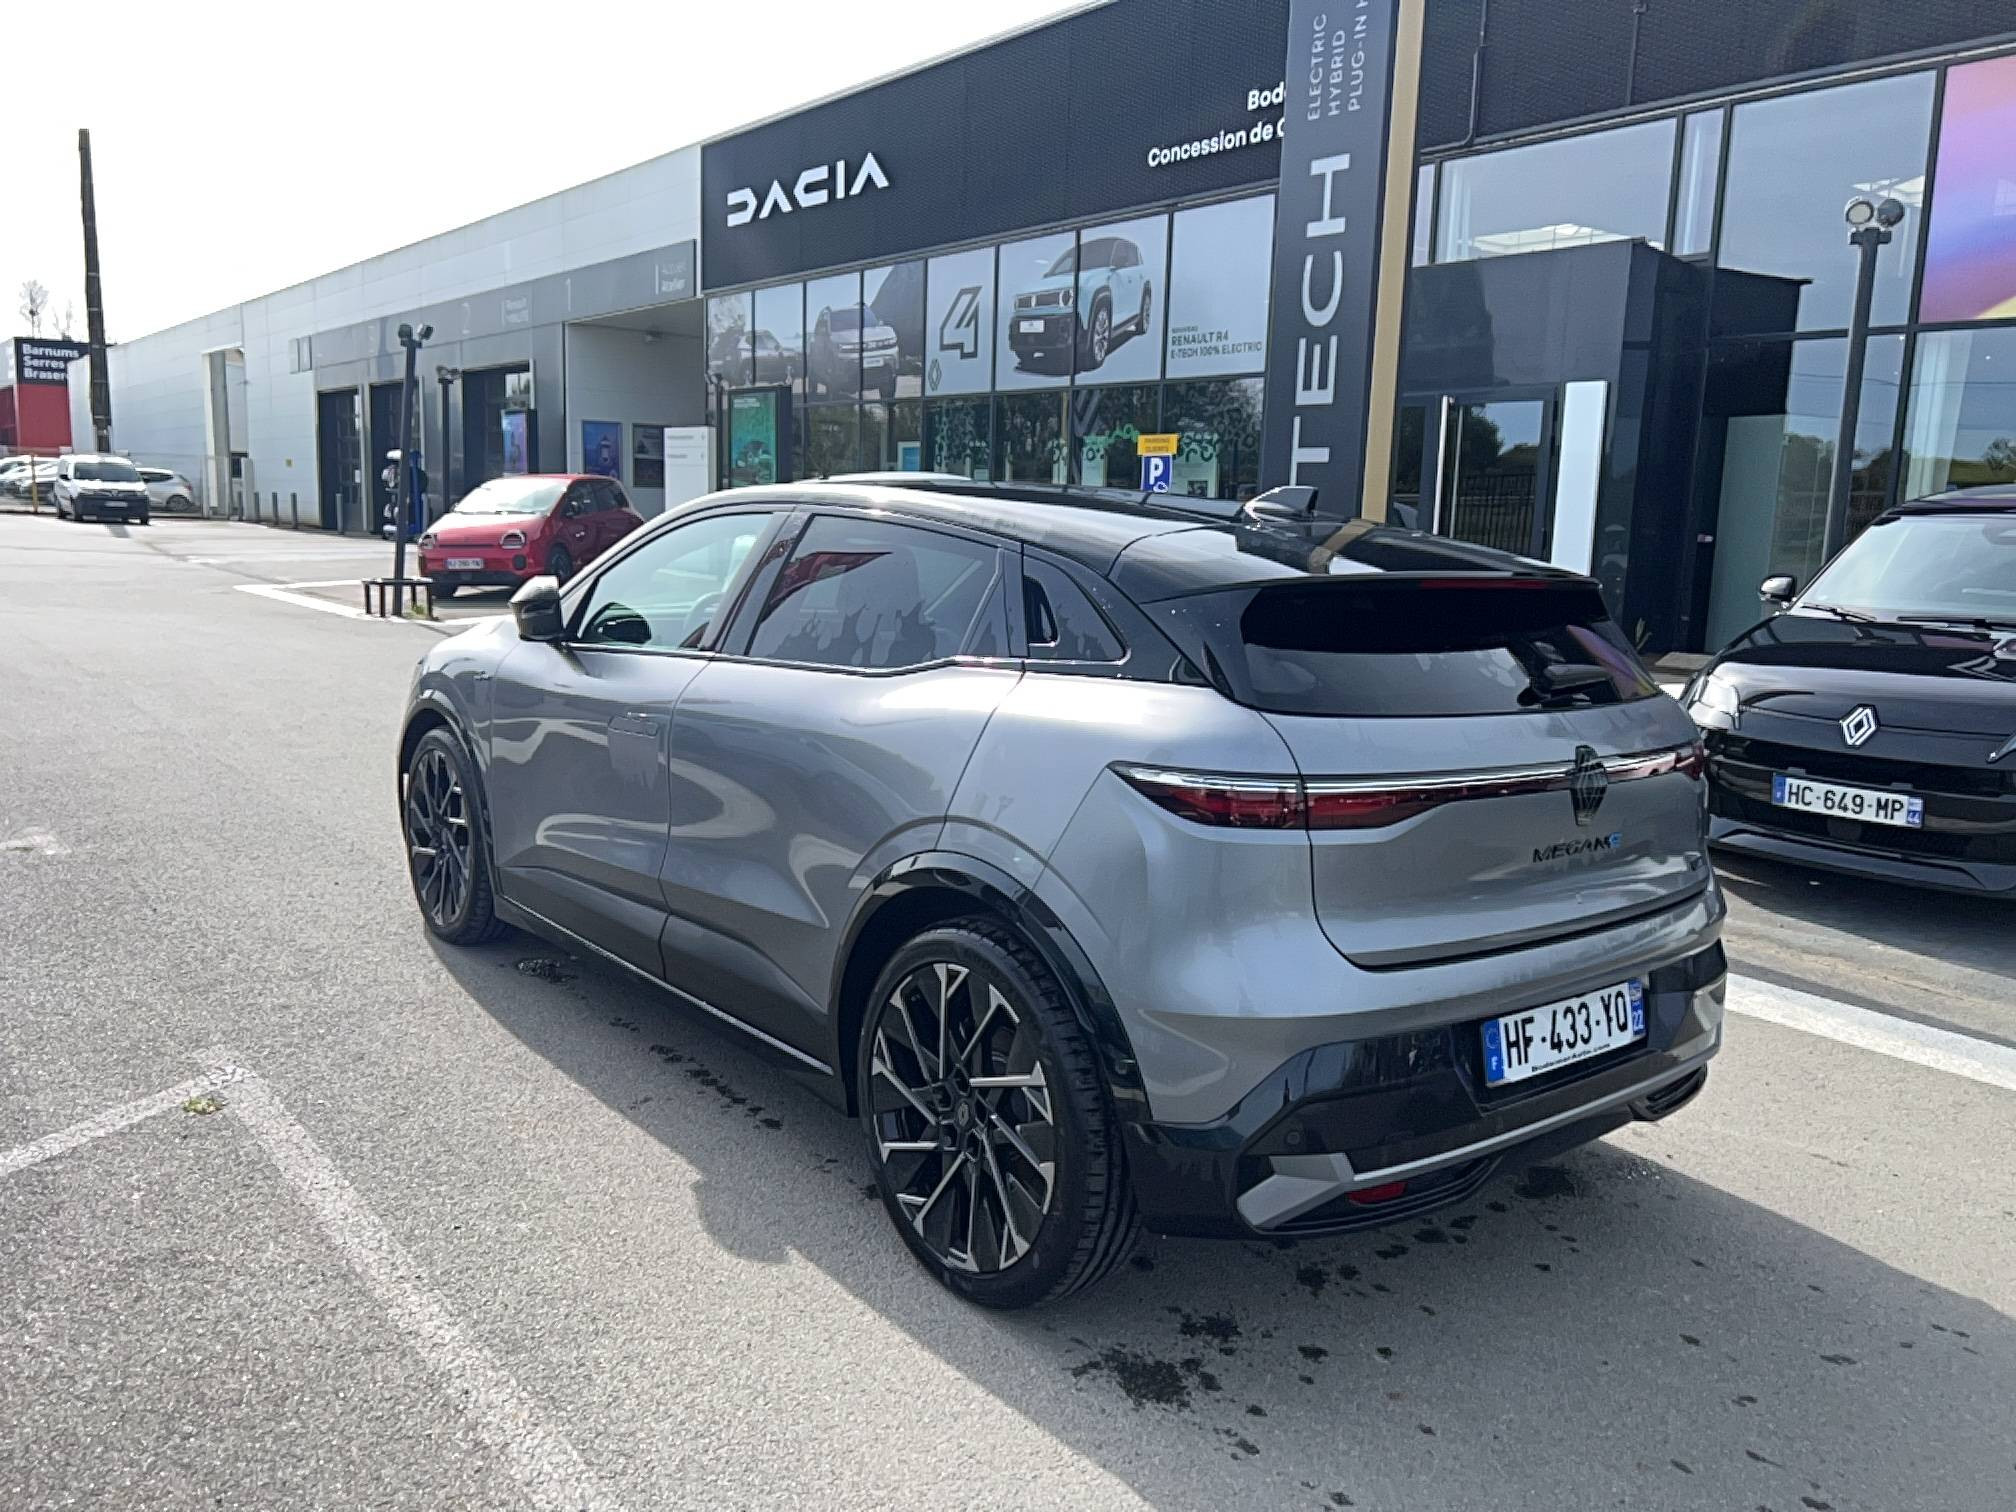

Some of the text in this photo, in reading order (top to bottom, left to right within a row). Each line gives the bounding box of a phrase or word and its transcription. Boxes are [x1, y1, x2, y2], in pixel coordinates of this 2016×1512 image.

[1307, 13, 1328, 121] ELECTRIC
[1328, 30, 1346, 116] HYBRID
[1348, 15, 1368, 111] PLUG-IN
[1247, 81, 1287, 111] Bod
[1147, 130, 1248, 168] Concession
[1250, 120, 1274, 144] de
[726, 152, 890, 228] DACIA
[940, 285, 982, 361] 4
[1171, 329, 1229, 346] RENAULT R4
[22, 343, 80, 358] Barnums
[23, 355, 66, 369] Serres
[1170, 341, 1263, 359] E-TECH 100% ELECTRIC
[1149, 457, 1164, 485] P
